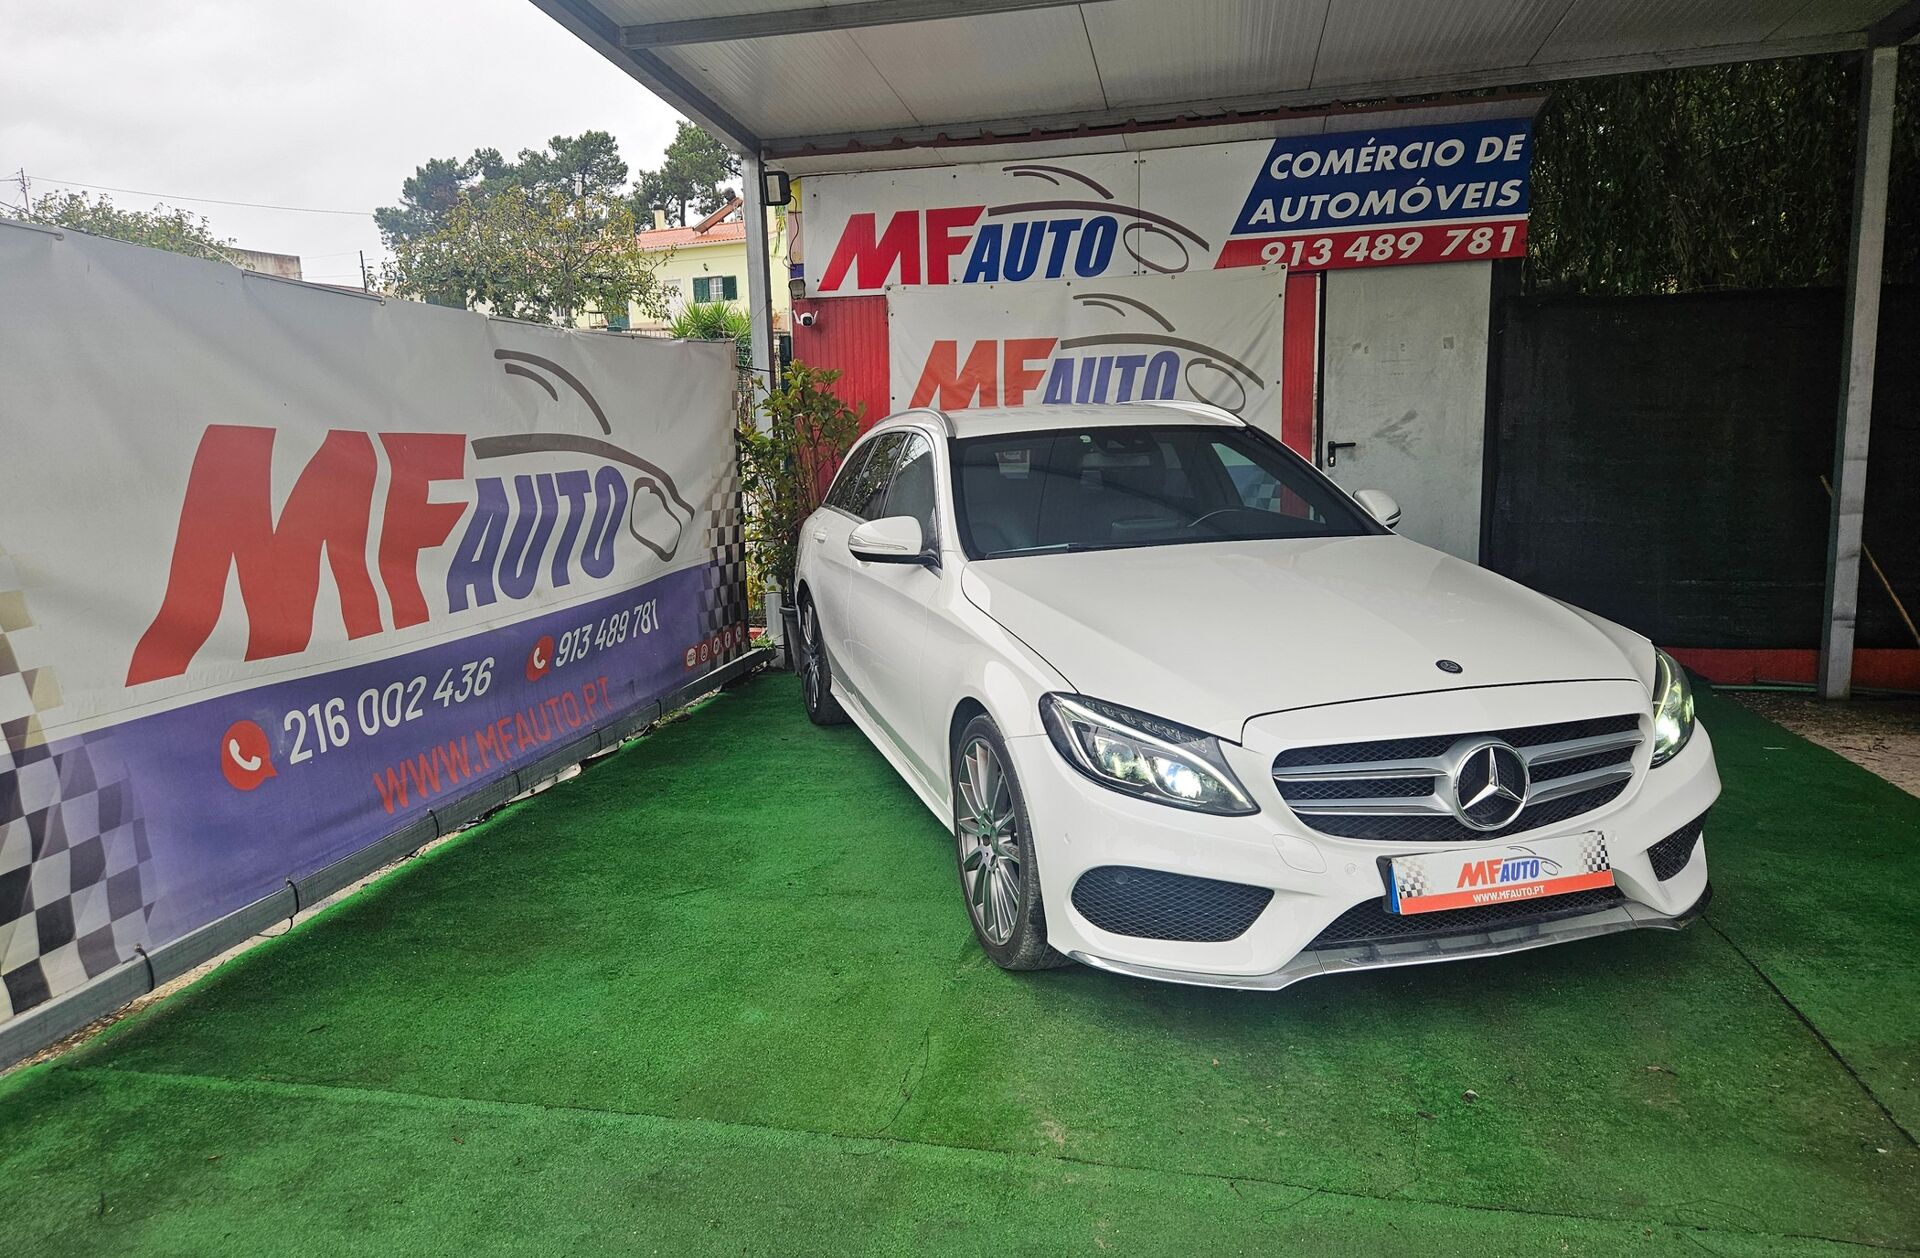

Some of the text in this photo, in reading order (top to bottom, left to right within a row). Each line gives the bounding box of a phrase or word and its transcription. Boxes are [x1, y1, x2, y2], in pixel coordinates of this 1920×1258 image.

[1270, 134, 1526, 180] COMÉRCIO DE
[1248, 178, 1523, 225] AUTOMÓVEIS
[1260, 225, 1518, 267] 913 489 781
[555, 598, 660, 667] 913 489 781
[284, 656, 495, 765] 216 002 436
[373, 677, 611, 814] WWW.MFAUTO.PT
[1473, 885, 1545, 904] WWW.MFAUTO.PT
